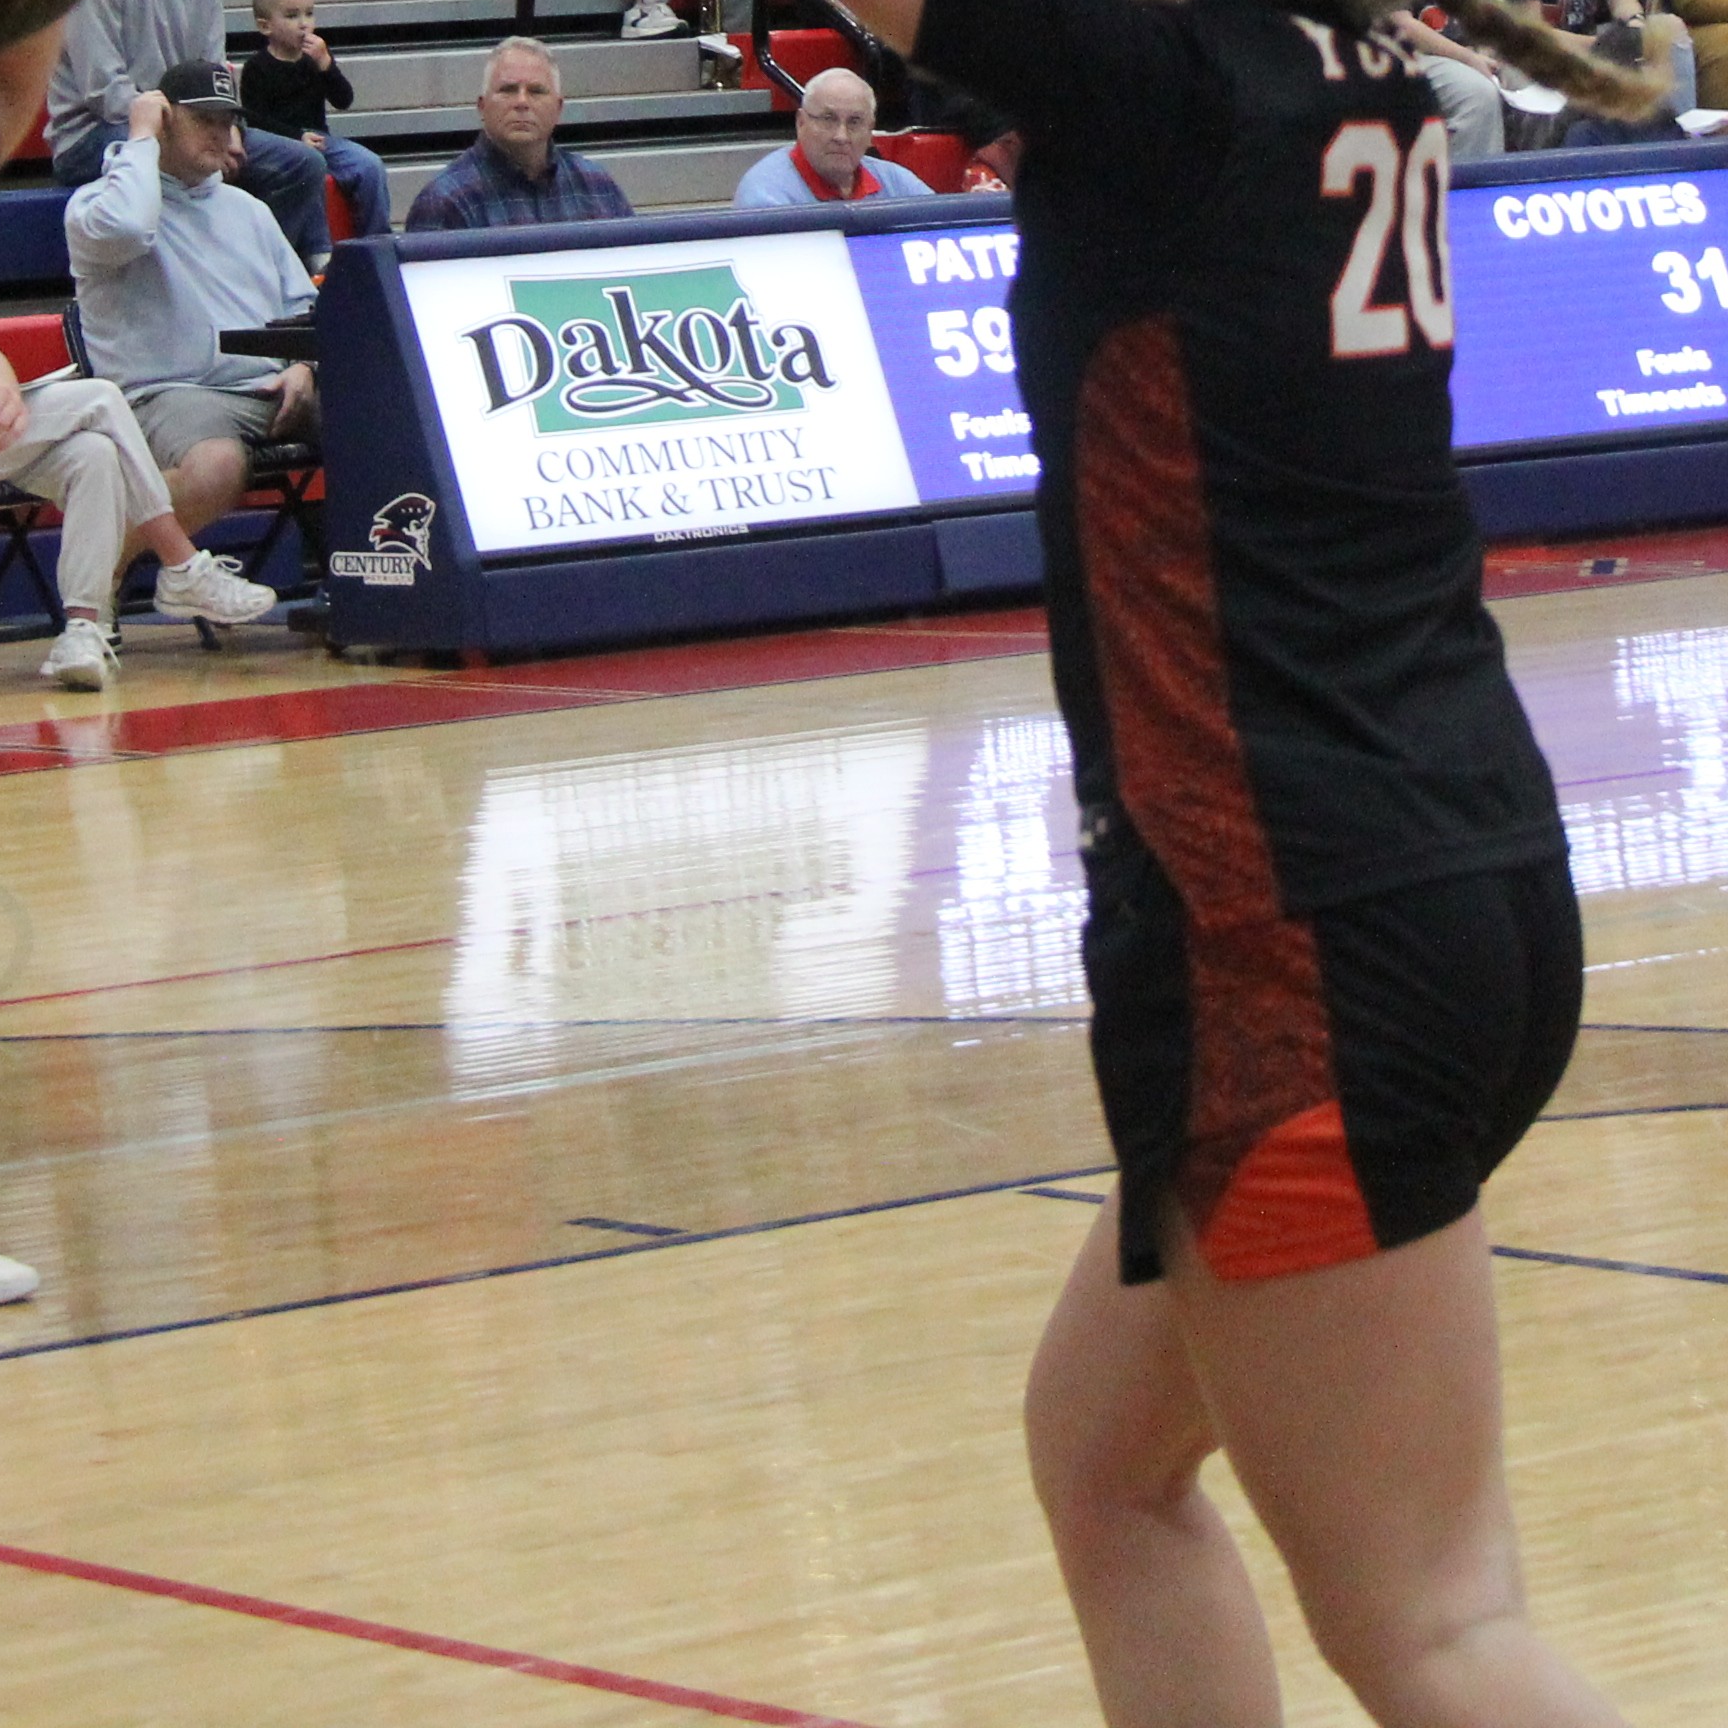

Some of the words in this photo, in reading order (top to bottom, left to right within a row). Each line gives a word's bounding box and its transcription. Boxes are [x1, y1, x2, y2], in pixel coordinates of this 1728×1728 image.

[1319, 116, 1454, 360] 20
[1493, 182, 1707, 240] COYOTES
[462, 289, 838, 414] Dakota
[926, 306, 1016, 378] 59
[1636, 345, 1713, 377] Fouls
[1595, 381, 1727, 417] Timeouts
[536, 427, 805, 484] COMMUNITY
[522, 486, 651, 531] BANK
[660, 482, 694, 516] &
[699, 467, 837, 514] TRUST
[653, 523, 750, 544] DAKTRONICS
[333, 555, 413, 574] CENTURY
